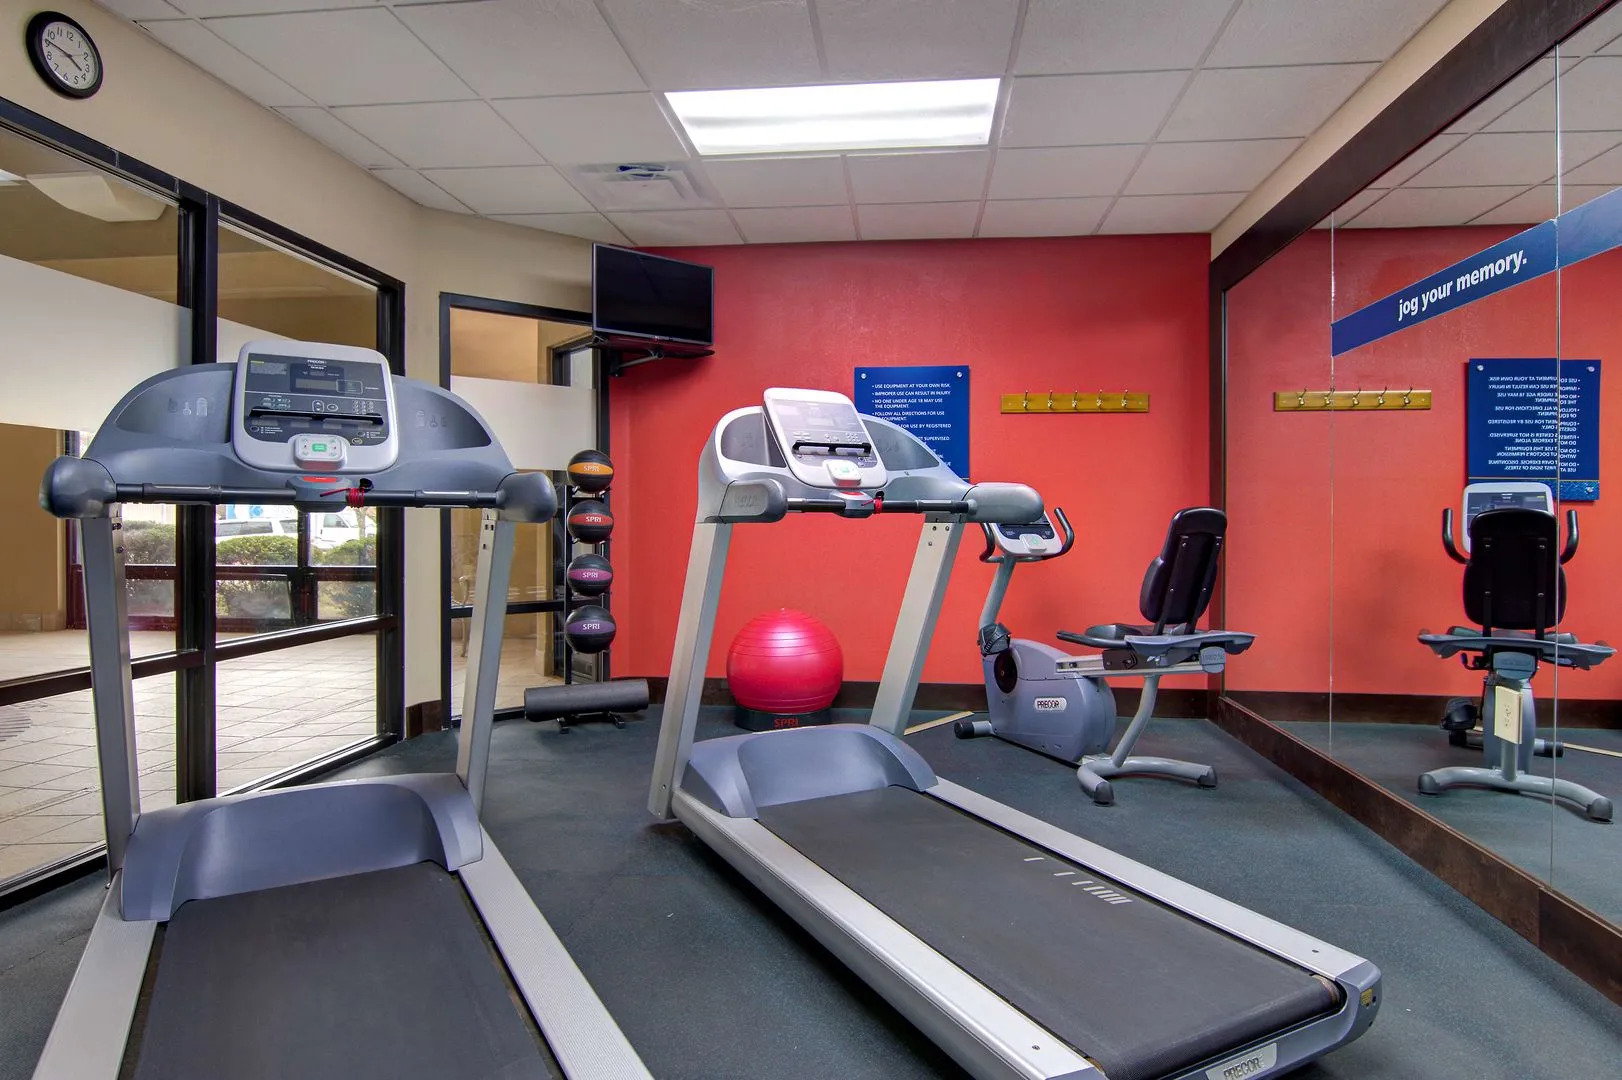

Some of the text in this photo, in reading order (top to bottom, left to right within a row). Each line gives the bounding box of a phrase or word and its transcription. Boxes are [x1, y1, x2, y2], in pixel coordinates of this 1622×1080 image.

[48, 29, 55, 40] 10
[57, 27, 62, 36] 11
[67, 30, 73, 41] 12
[47, 51, 52, 60] 8
[84, 52, 88, 62] 2
[54, 63, 59, 71] 7
[85, 64, 89, 72] 3
[63, 73, 68, 81] 6
[74, 76, 79, 84] 5
[81, 73, 86, 81] 4
[1399, 250, 1527, 321] jog your memory.
[1037, 700, 1060, 709] PRECOR
[774, 718, 798, 728] SPRI
[1223, 1057, 1261, 1080] PRECOR
